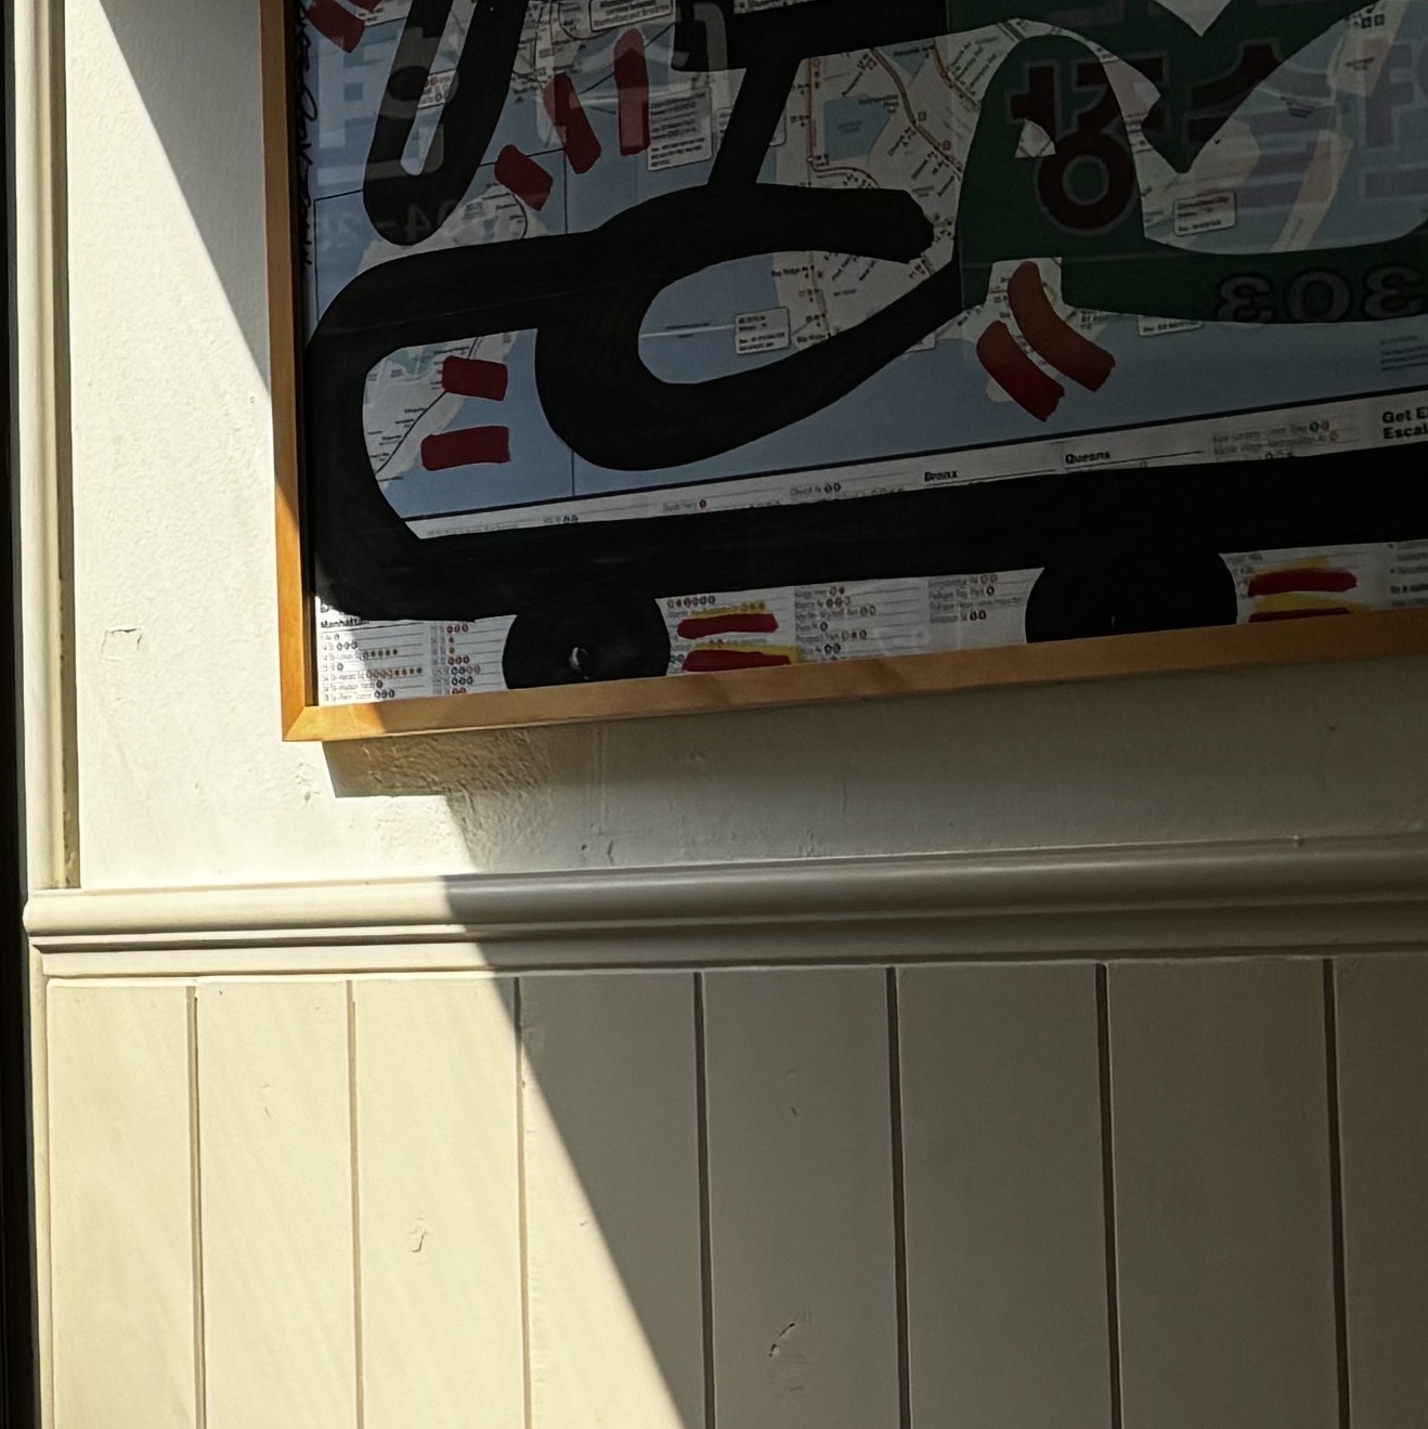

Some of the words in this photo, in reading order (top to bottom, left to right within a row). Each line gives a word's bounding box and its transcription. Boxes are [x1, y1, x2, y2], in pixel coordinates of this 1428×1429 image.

[1381, 410, 1411, 424] Get
[1383, 424, 1428, 440] Escal
[1064, 448, 1111, 465] Queens
